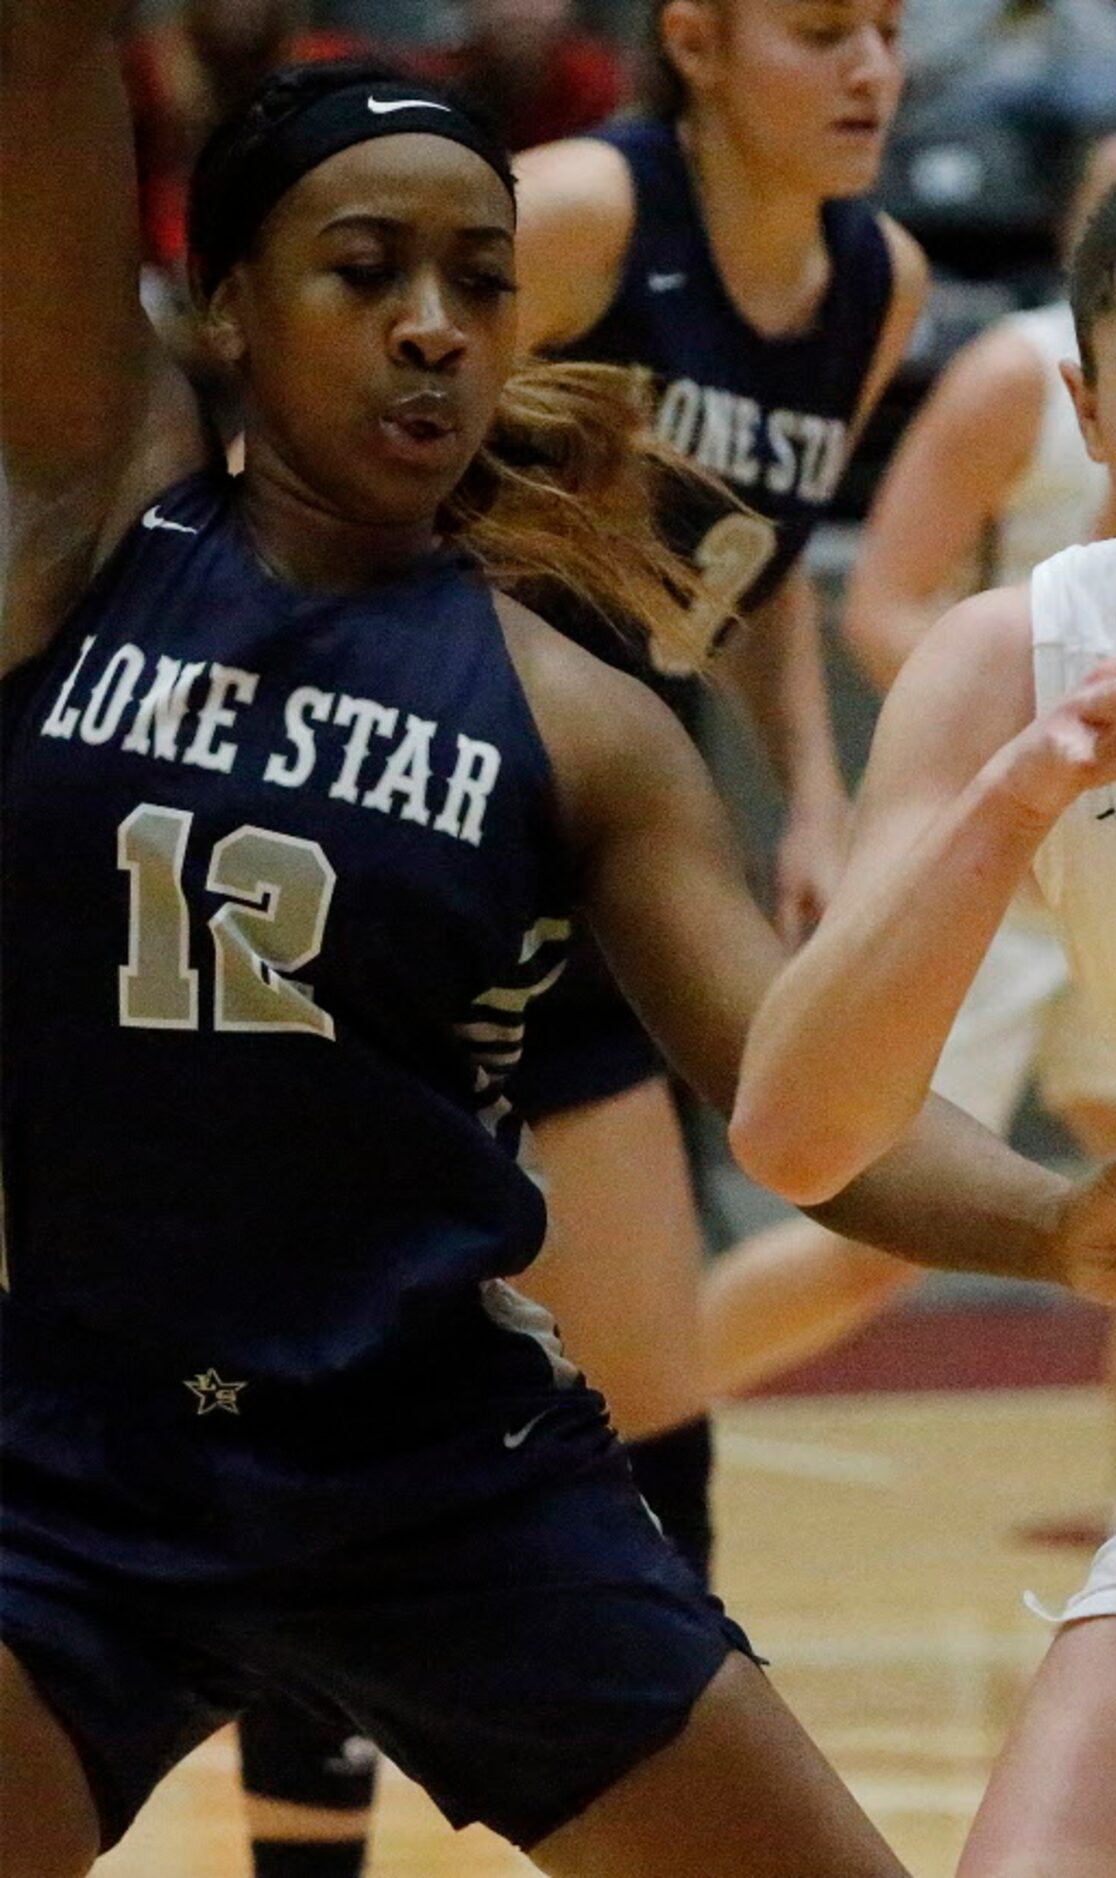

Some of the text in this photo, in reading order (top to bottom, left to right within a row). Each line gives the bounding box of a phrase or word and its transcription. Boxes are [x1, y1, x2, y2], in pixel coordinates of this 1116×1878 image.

[41, 634, 501, 848] LONE STAR
[118, 802, 336, 1041] 12
